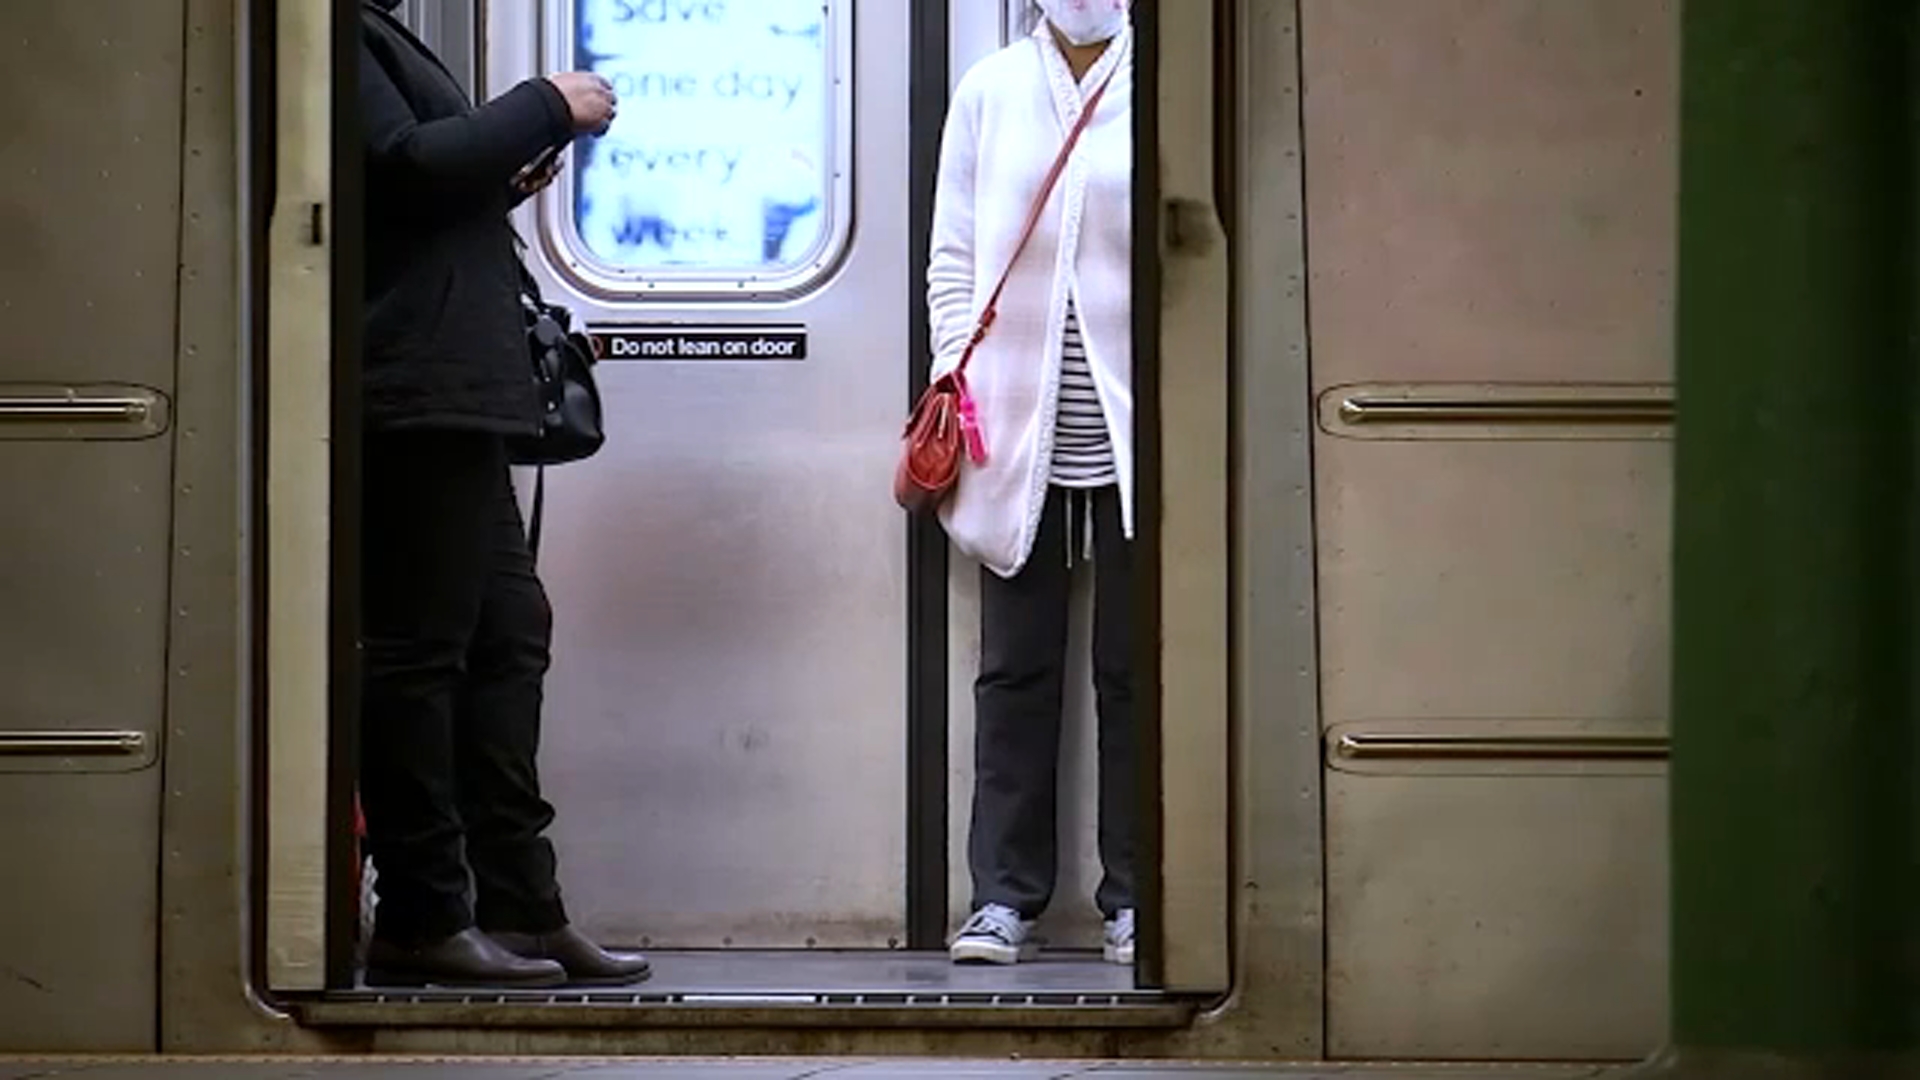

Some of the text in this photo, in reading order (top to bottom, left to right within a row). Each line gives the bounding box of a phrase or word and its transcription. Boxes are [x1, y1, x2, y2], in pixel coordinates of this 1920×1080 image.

[613, 62, 803, 113] one day
[609, 146, 742, 187] every
[611, 337, 797, 355] Do not lean on door
